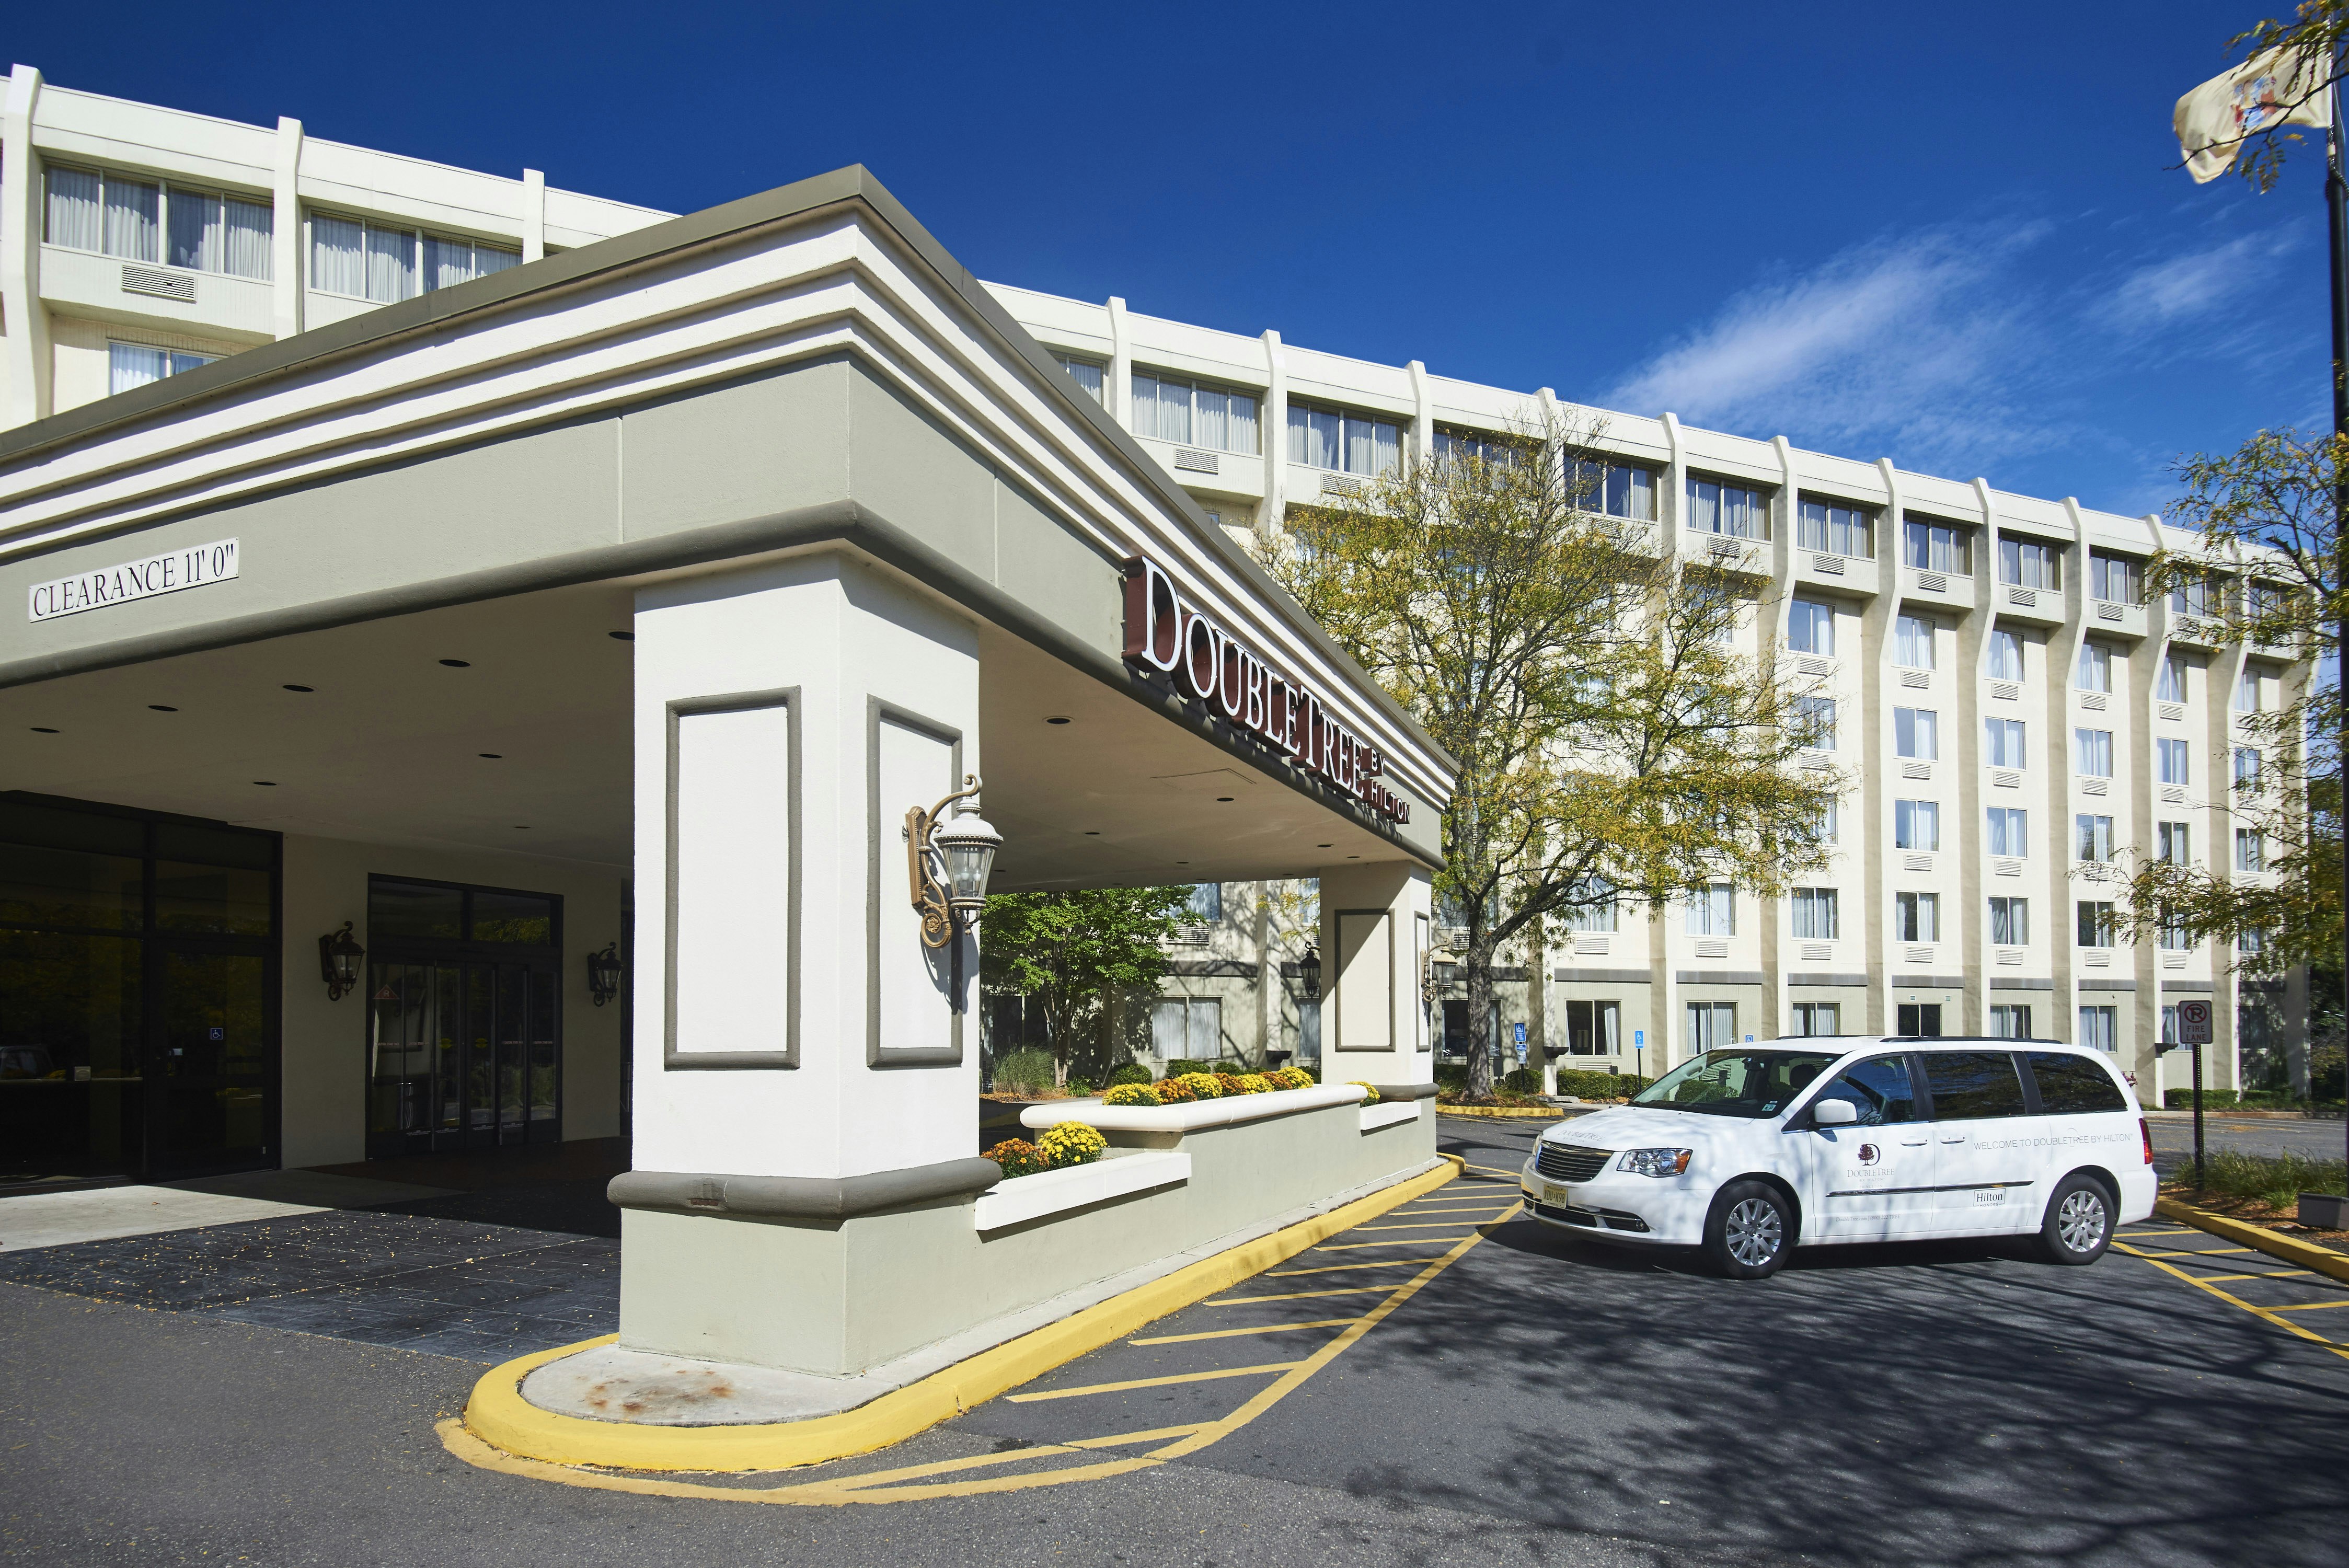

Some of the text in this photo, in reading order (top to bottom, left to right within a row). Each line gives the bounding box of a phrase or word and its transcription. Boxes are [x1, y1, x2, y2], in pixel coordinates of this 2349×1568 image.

[34, 557, 176, 616] CLEARANCE
[1371, 748, 1386, 777] BY
[1371, 779, 1410, 824] HILTON
[1974, 1140, 2018, 1150] WELCOME
[2034, 1136, 2089, 1146] DOUBLETREE
[1977, 1193, 2002, 1202] Hilton
